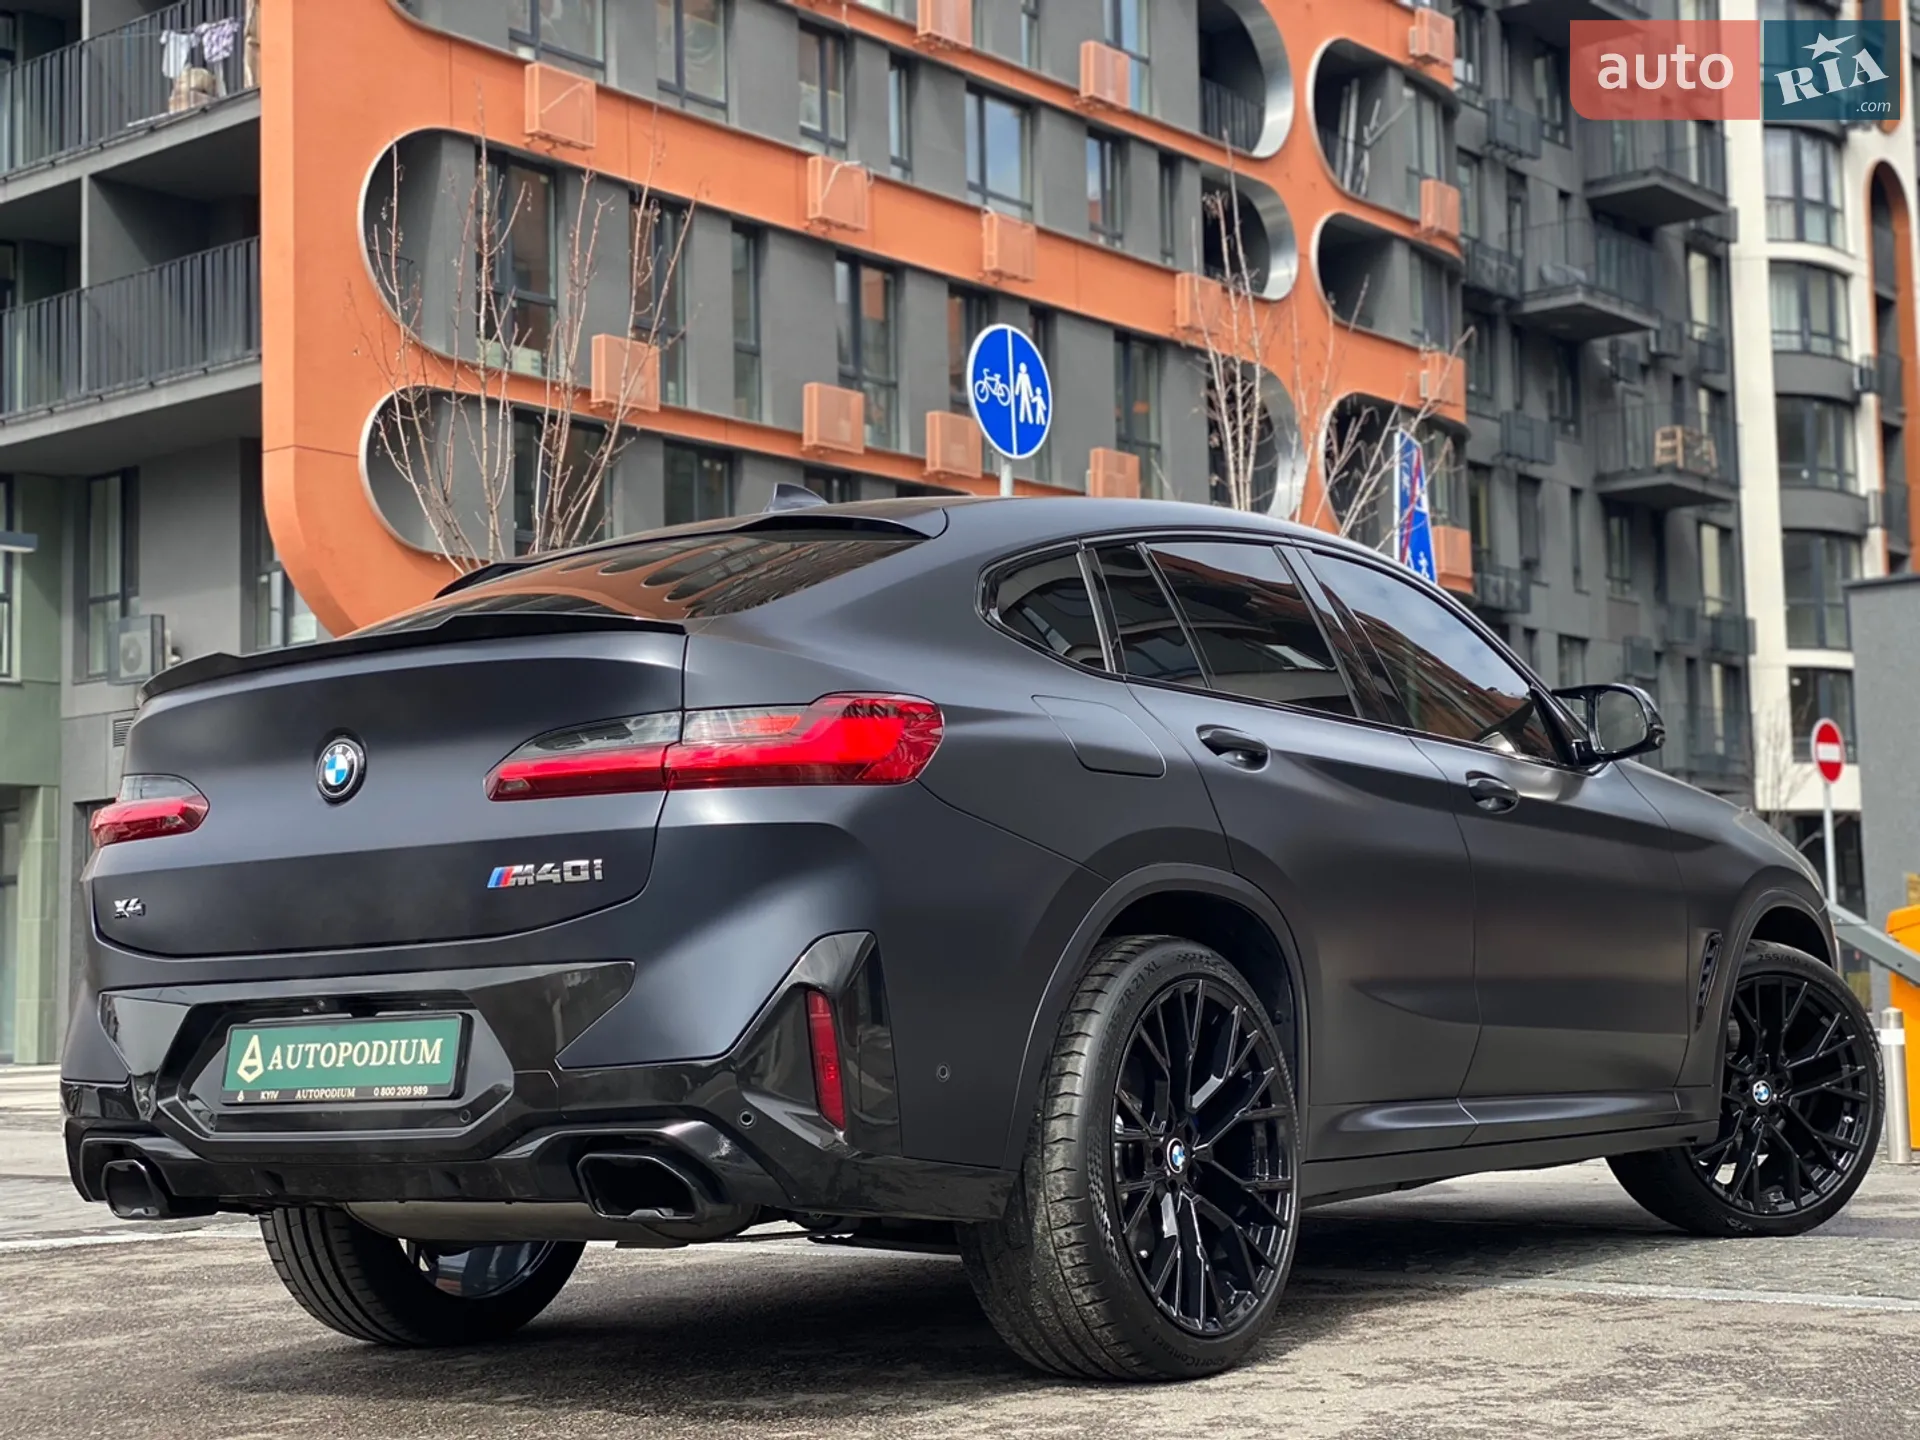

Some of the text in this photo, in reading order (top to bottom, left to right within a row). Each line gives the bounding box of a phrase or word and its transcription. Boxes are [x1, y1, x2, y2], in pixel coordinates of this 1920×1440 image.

[323, 746, 355, 762] BMW
[113, 898, 146, 918] X4
[1144, 960, 1162, 976] XL
[267, 1037, 444, 1070] AUTOPODIUM
[295, 1087, 356, 1100] AUTOPODIUM
[373, 1087, 379, 1097] 0
[380, 1087, 396, 1097] 800
[396, 1086, 412, 1097] 209
